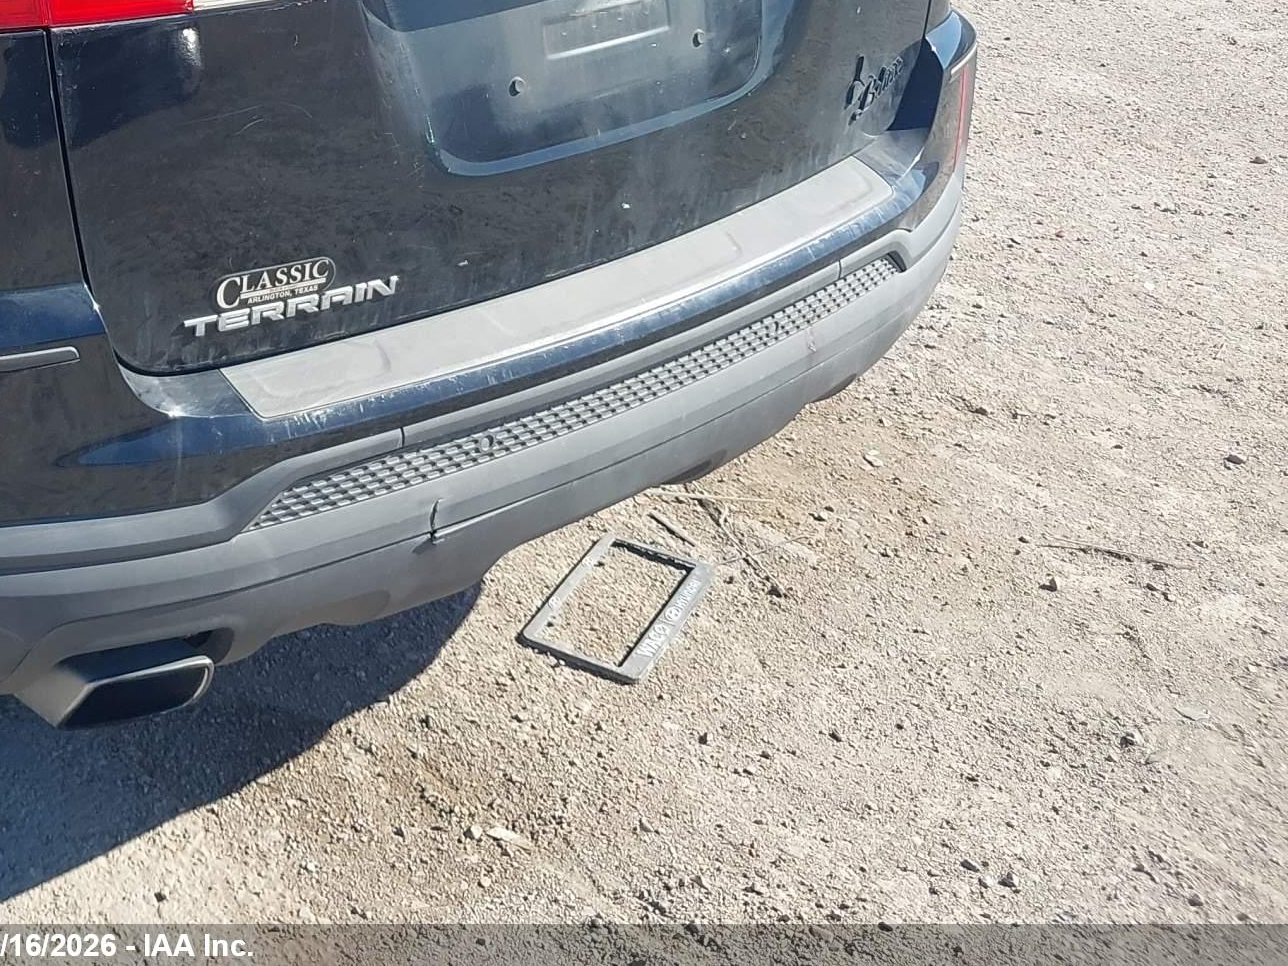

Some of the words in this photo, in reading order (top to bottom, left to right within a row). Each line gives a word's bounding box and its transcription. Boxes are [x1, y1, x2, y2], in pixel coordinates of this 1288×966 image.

[216, 258, 330, 310] CLASSIC
[247, 290, 292, 305] ARLINGTON,
[294, 284, 319, 296] TEXAS
[183, 275, 400, 338] TERRAIN
[634, 623, 670, 658] WACO
